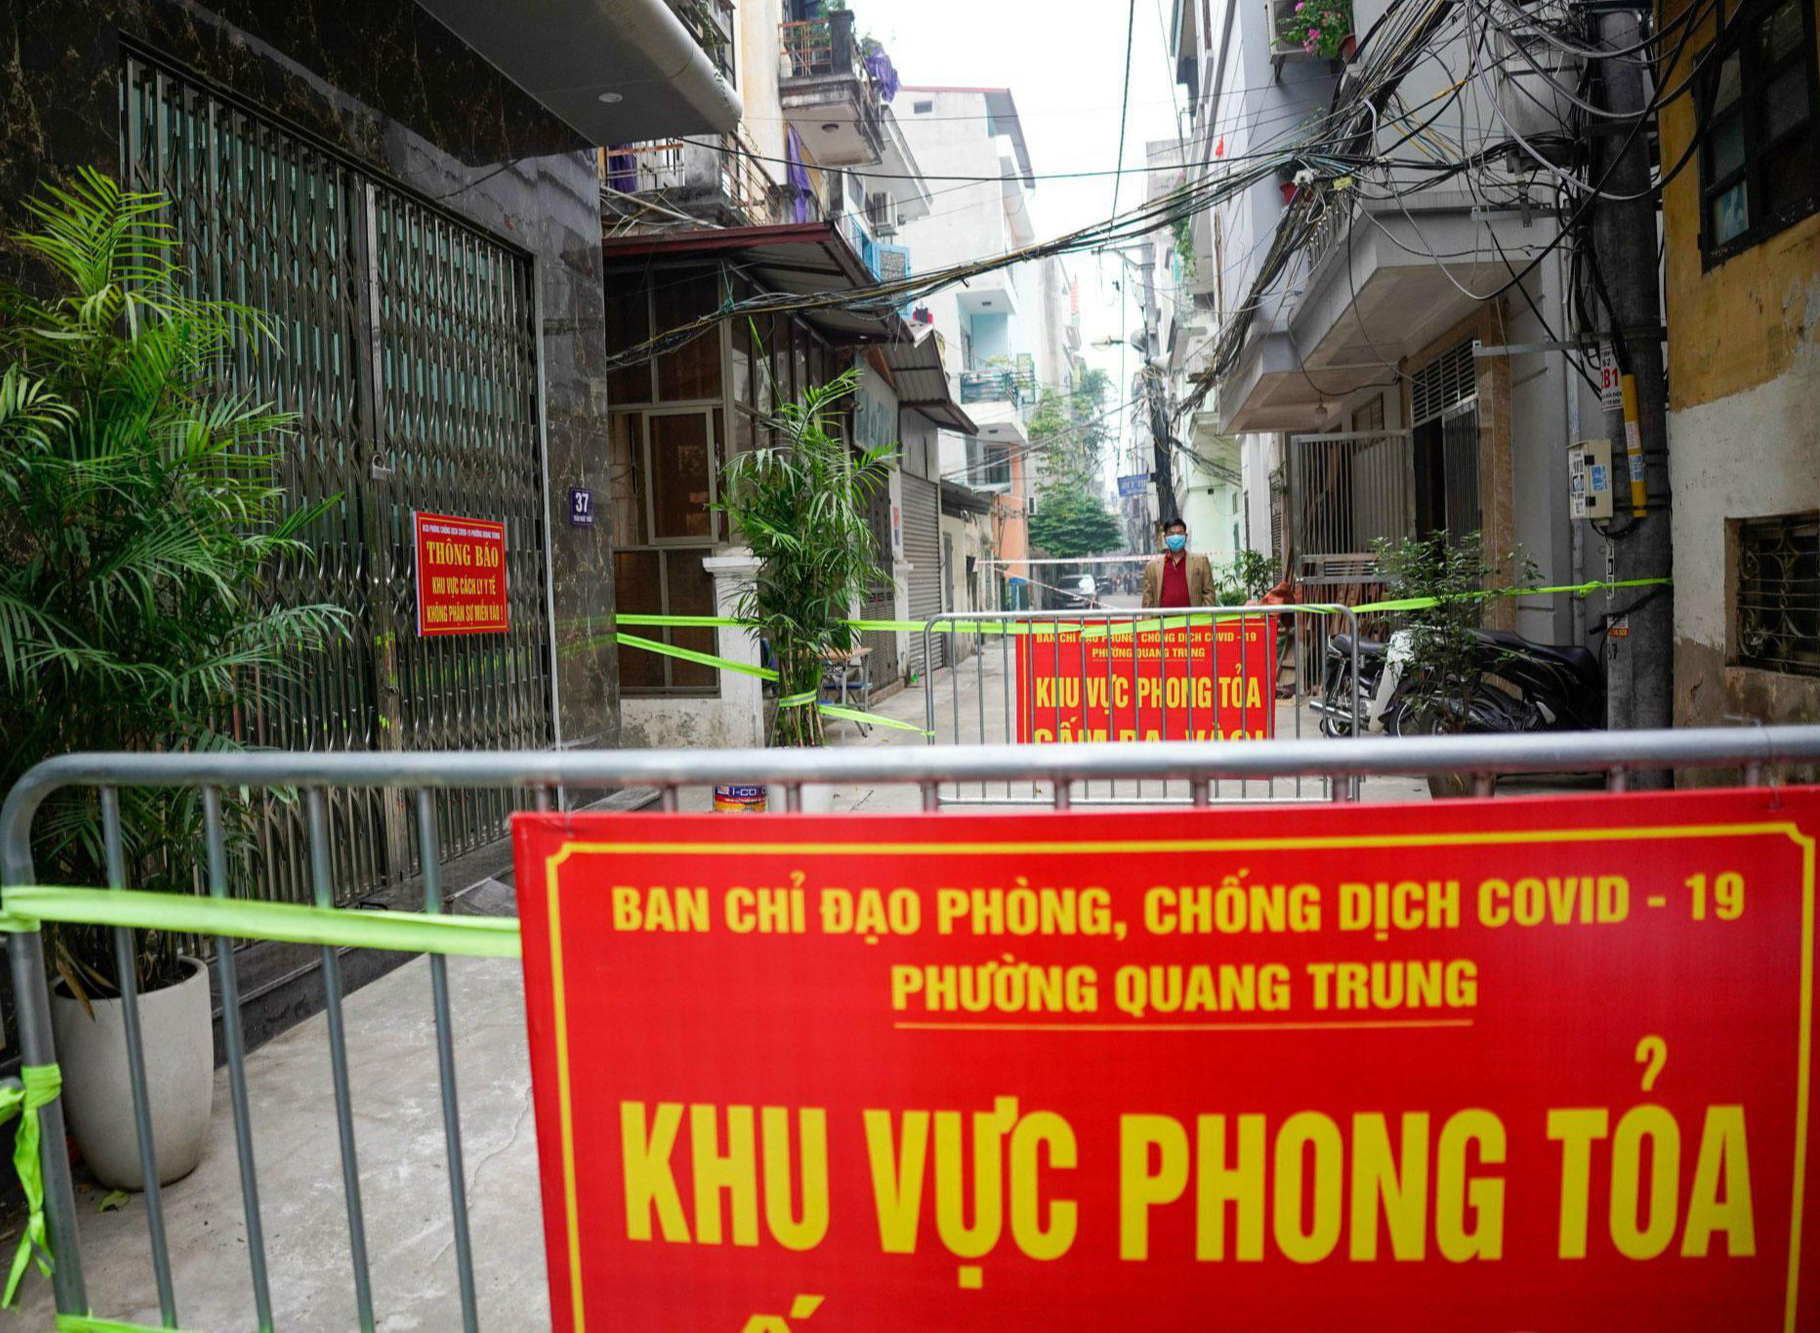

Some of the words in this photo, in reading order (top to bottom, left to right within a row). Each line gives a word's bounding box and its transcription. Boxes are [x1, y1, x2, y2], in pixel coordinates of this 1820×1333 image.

[575, 492, 589, 513] 37
[426, 537, 471, 566] THÔNG
[475, 541, 499, 568] BÁO
[432, 576, 446, 594] KHU
[447, 576, 459, 598] VỰC
[460, 574, 476, 595] CÁCH
[427, 601, 448, 623] KHÔNG
[1036, 677, 1080, 708] KHU
[1086, 674, 1129, 715] VỰC
[1137, 677, 1212, 709] PHONG
[1218, 663, 1262, 709] TỎA
[611, 886, 711, 932] BAN
[724, 870, 806, 934] CHỈ
[819, 888, 922, 945] ĐẠO
[936, 876, 1128, 941] PHÒNG,
[1143, 867, 1322, 935] CHỐNG
[1338, 881, 1461, 941] DỊCH
[1477, 876, 1630, 928] COVID
[1647, 897, 1667, 907] -
[1684, 872, 1745, 921] 19
[890, 953, 1099, 1013] PHƯỜNG
[1114, 963, 1292, 1018] QUANG
[1306, 960, 1478, 1011] TRUNG
[620, 1101, 829, 1251] KHU
[863, 1096, 1078, 1290] VỰC
[1120, 1109, 1507, 1263] PHONG
[1547, 1035, 1756, 1260] TỎA
